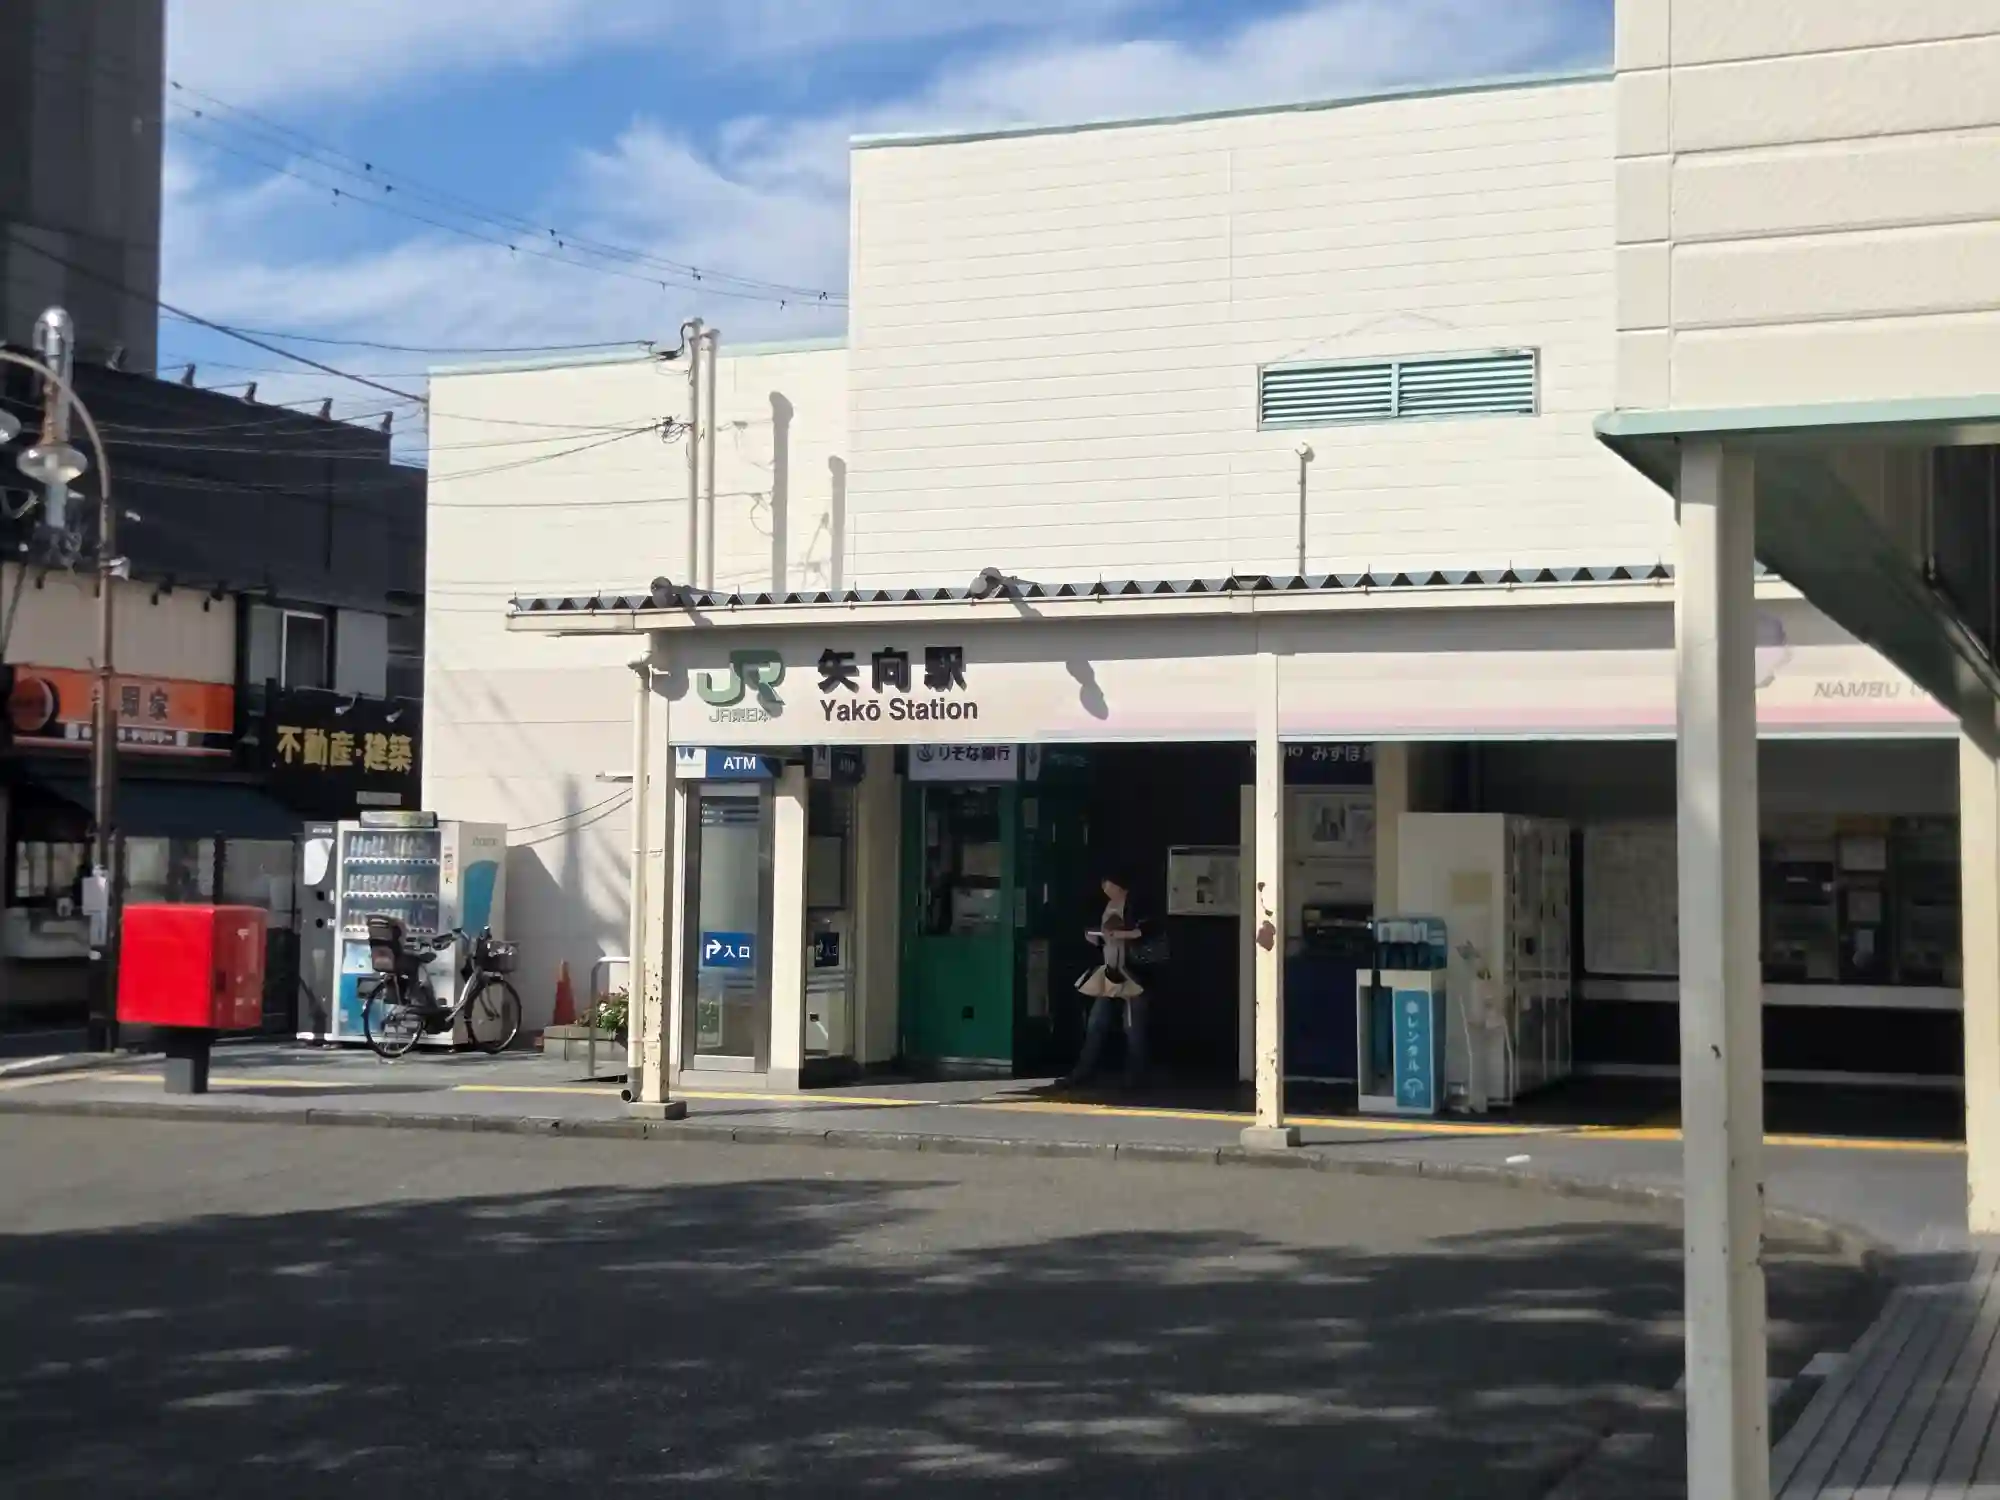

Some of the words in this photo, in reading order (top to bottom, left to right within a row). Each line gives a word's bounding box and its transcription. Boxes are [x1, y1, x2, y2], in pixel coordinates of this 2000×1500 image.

[696, 650, 786, 707] JR
[817, 647, 967, 693] 矢向駅
[1814, 681, 1900, 699] NAMBU
[820, 699, 881, 721] Yakō
[889, 698, 978, 720] Station
[723, 756, 756, 770] ATM
[939, 745, 1010, 761] りそな銀行
[723, 945, 750, 959] 入口
[1406, 1016, 1420, 1072] レンタル
